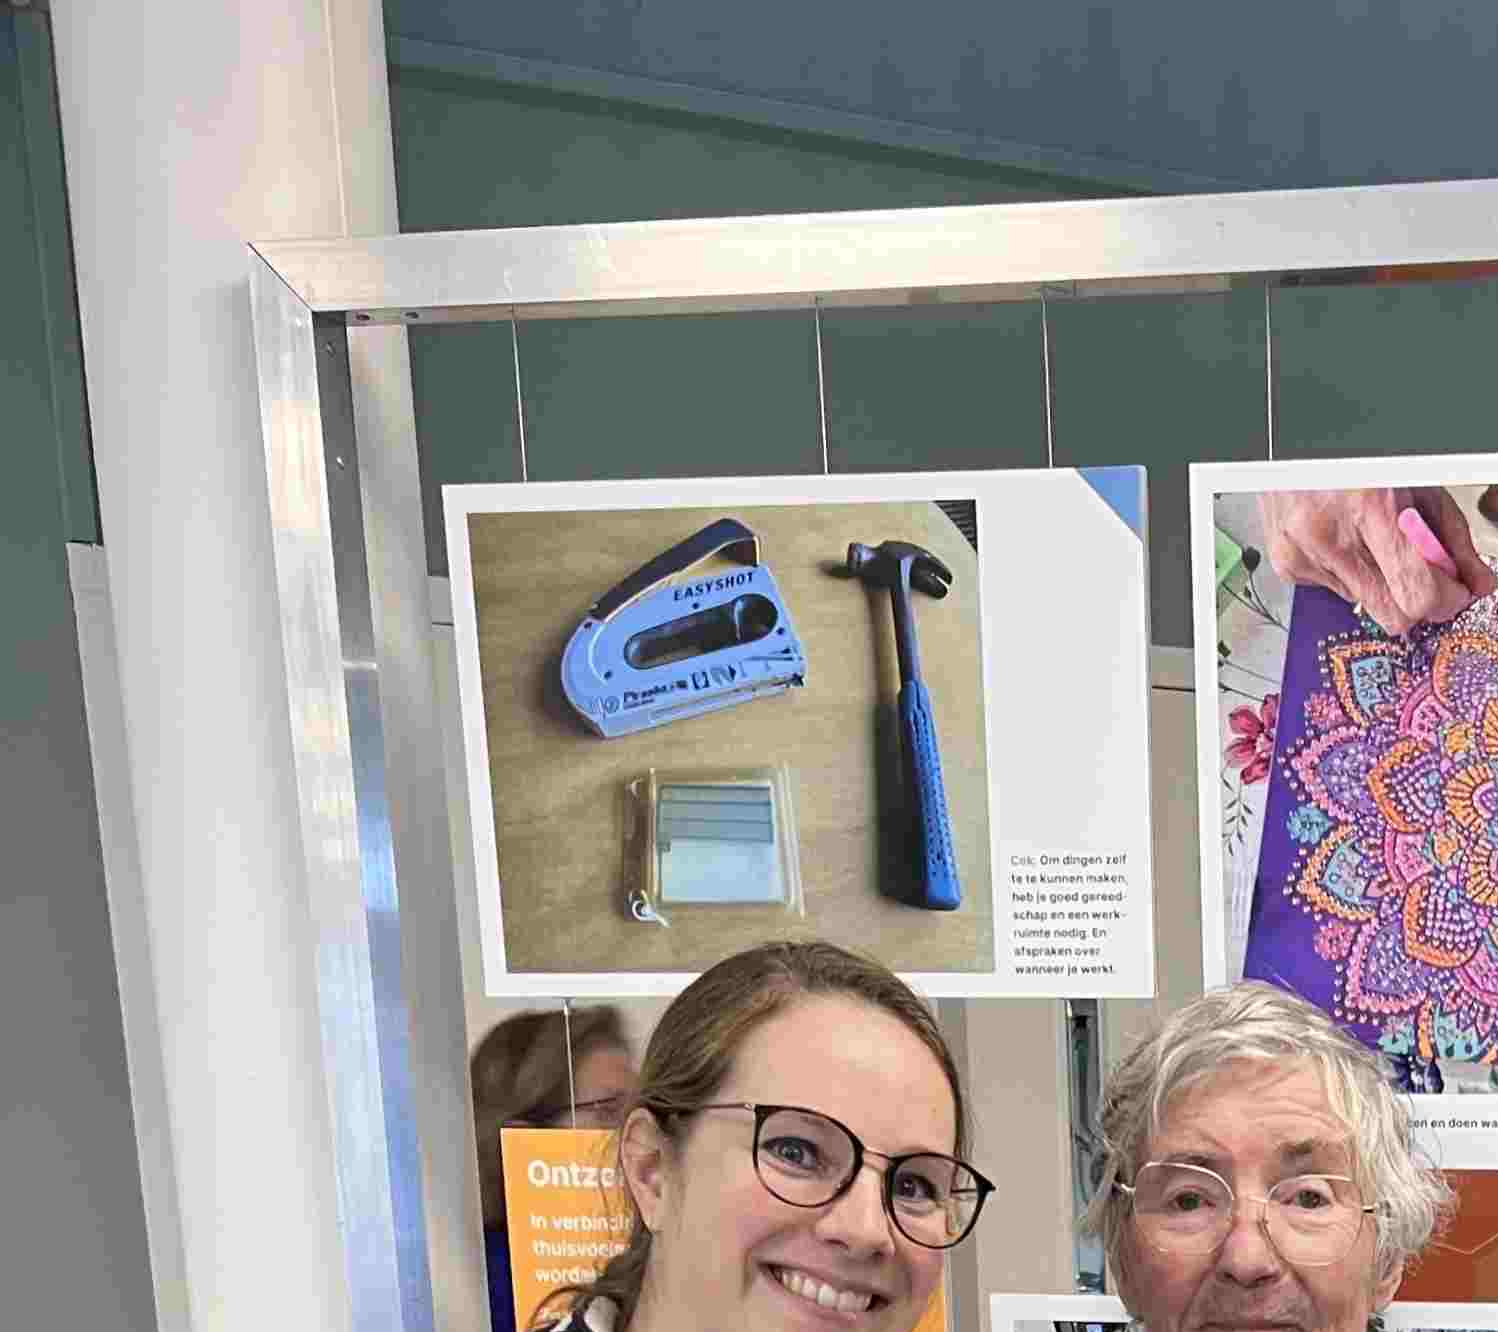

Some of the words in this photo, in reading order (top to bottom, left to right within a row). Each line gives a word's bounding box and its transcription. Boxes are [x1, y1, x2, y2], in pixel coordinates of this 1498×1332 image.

[673, 571, 754, 602] EASYSHOT
[1431, 1119, 1446, 1129] en
[1448, 1117, 1478, 1129] doen
[528, 1159, 624, 1187] Ontzo
